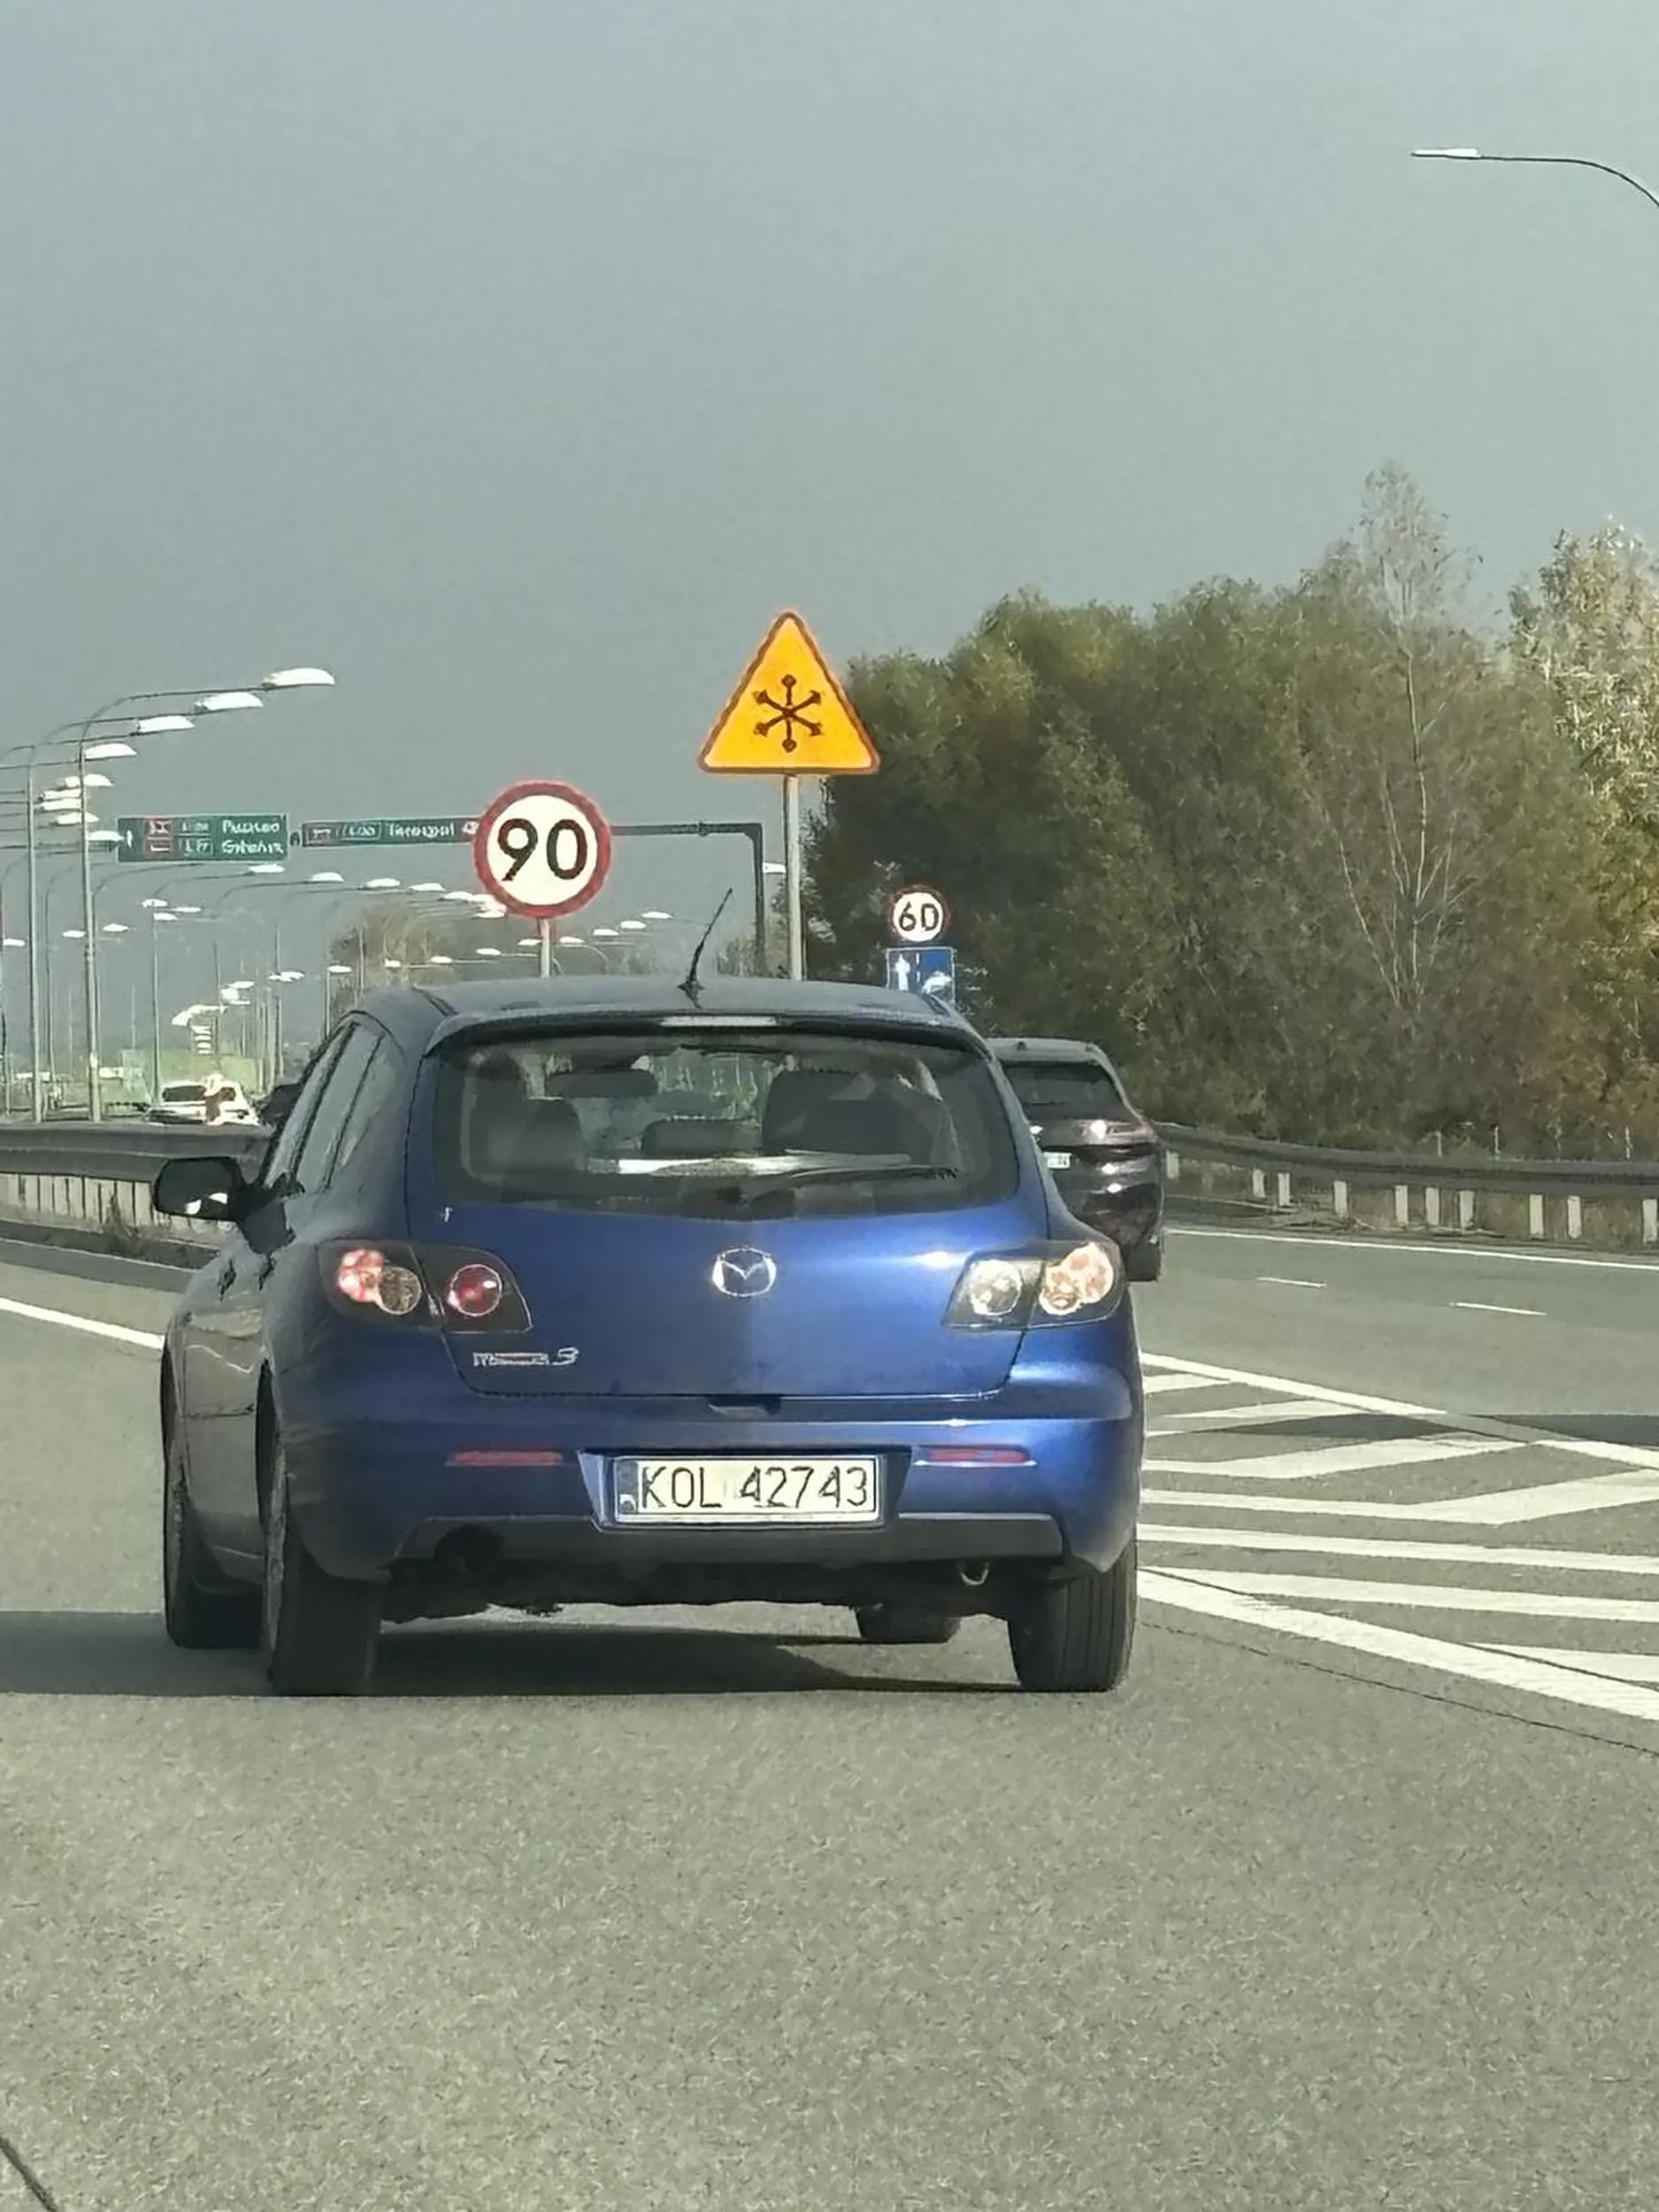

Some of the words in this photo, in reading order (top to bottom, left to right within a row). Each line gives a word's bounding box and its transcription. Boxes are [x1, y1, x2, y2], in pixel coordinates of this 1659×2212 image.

[497, 818, 588, 881] 90
[898, 901, 940, 932] 60
[641, 1465, 722, 1508] KOL
[740, 1465, 868, 1509] 42743
